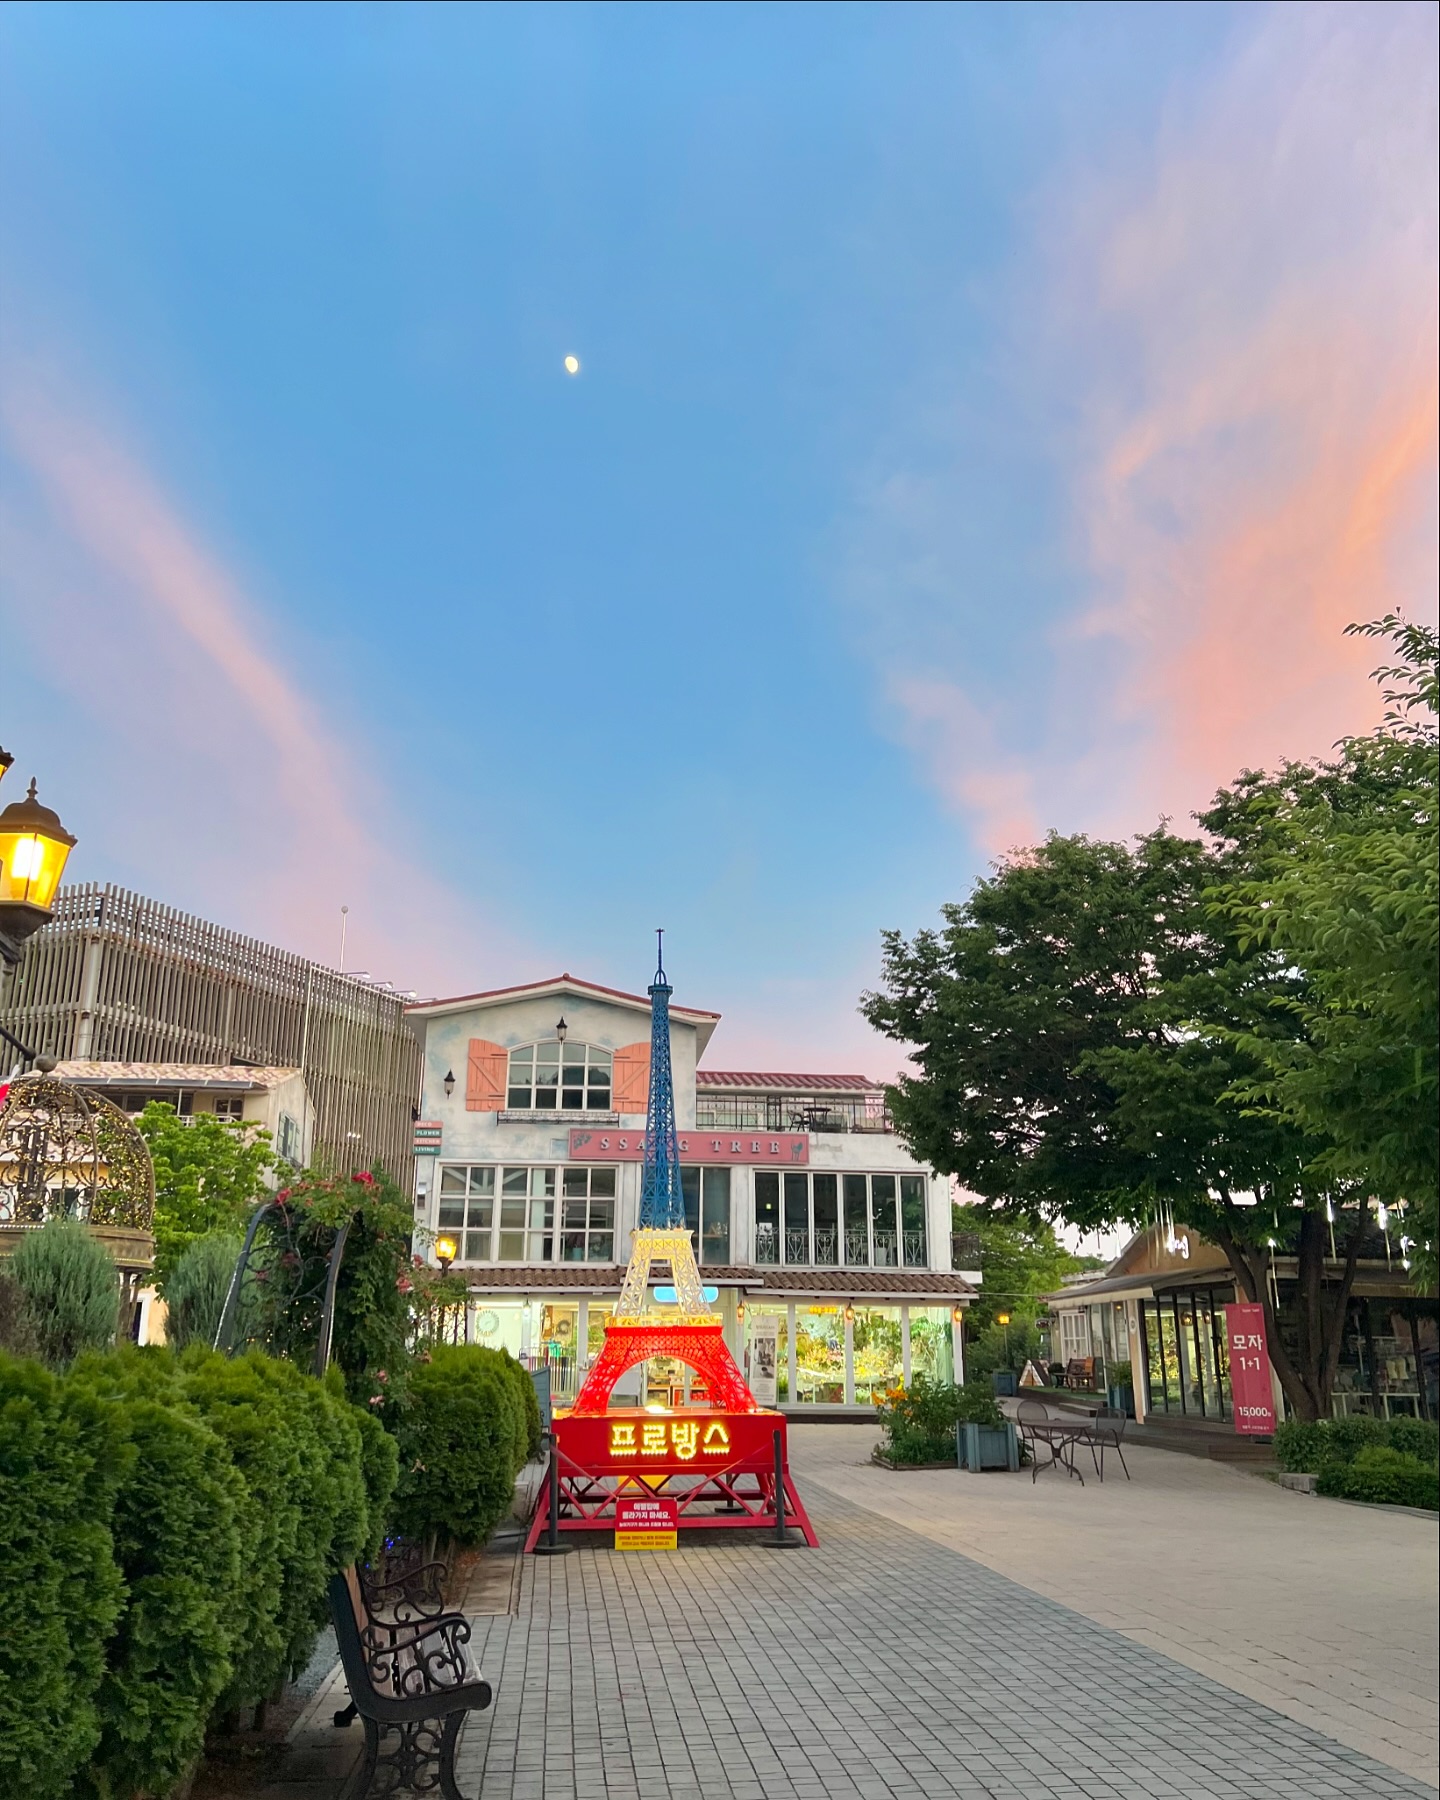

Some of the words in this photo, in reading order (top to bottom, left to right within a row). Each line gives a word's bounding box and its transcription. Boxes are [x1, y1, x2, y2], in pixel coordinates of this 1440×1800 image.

[600, 1137, 690, 1152] SSAG
[711, 1139, 780, 1154] TREE
[1232, 1334, 1263, 1352] 모자
[1239, 1357, 1261, 1371] 1+1
[610, 1423, 730, 1460] 프로방스
